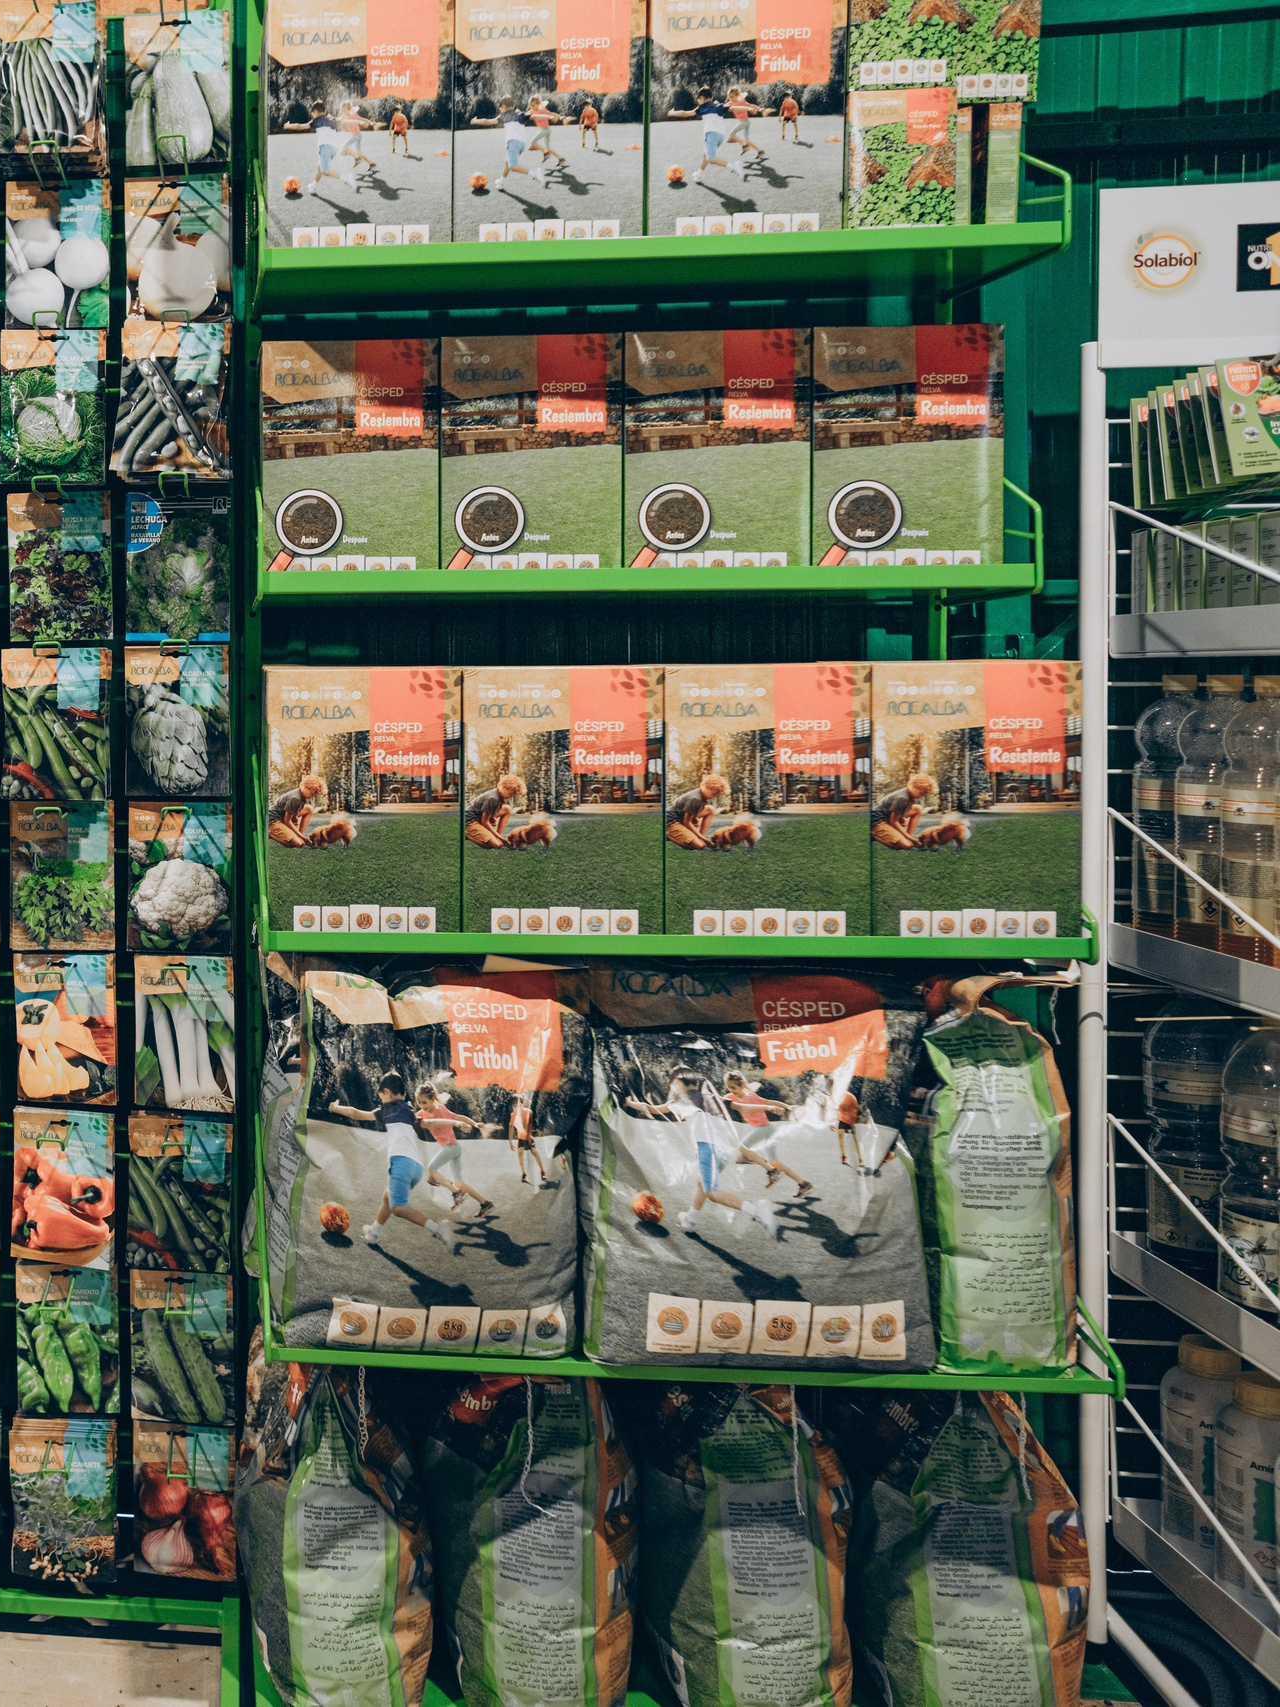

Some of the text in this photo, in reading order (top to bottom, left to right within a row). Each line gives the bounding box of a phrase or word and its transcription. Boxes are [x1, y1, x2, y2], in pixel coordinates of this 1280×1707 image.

[668, 15, 743, 31] ROCALBA
[283, 31, 354, 47] ROCALBA
[470, 25, 543, 40] ROCALBA
[761, 27, 811, 40] CÉSPED
[371, 43, 419, 56] CÉSPED
[561, 37, 610, 50] CÉSPED
[761, 55, 801, 71] Fútbol
[372, 70, 410, 87] Fútbol
[561, 63, 600, 81] Fútbol
[909, 110, 937, 118] CÉSPED
[1247, 244, 1272, 252] NUTRI
[1133, 252, 1198, 269] Solabiol
[1229, 366, 1257, 375] PROTECT
[728, 377, 774, 389] CÉSPED
[920, 373, 968, 385] CÉSPED
[360, 386, 403, 397] CÉSPED
[542, 381, 587, 393] CÉSPED
[542, 407, 604, 423] Resiembra
[728, 404, 792, 420] Resiembra
[920, 401, 986, 416] Resiembra
[360, 413, 420, 427] Resiembra
[300, 536, 318, 544] Antes
[342, 535, 368, 544] Después
[480, 533, 500, 541] Antes
[524, 532, 550, 541] Después
[665, 531, 685, 540] Antes
[710, 530, 737, 540] Después
[855, 528, 876, 538] Antes
[901, 528, 929, 538] Después
[181, 670, 217, 679] ALCACHOFA
[281, 706, 355, 719] ROCALBA
[479, 704, 555, 719] ROCALBA
[680, 702, 759, 719] ROCALBA
[886, 701, 970, 717] ROCALBA
[374, 720, 422, 734] CÉSPED
[574, 719, 624, 732] CÉSPED
[779, 717, 831, 731] CÉSPED
[989, 715, 1043, 730] CÉSPED
[374, 749, 440, 767] Resistente
[574, 748, 642, 766] Resistente
[779, 747, 850, 766] Resistente
[989, 745, 1061, 764] Resistente
[66, 978, 87, 988] MELÓN
[453, 999, 527, 1021] CÉSPED
[763, 998, 846, 1018] CÉSPED
[458, 1042, 518, 1071] Fútbol
[769, 1037, 837, 1062] Fútbol
[443, 1320, 451, 1331] 5
[772, 1318, 781, 1329] 5
